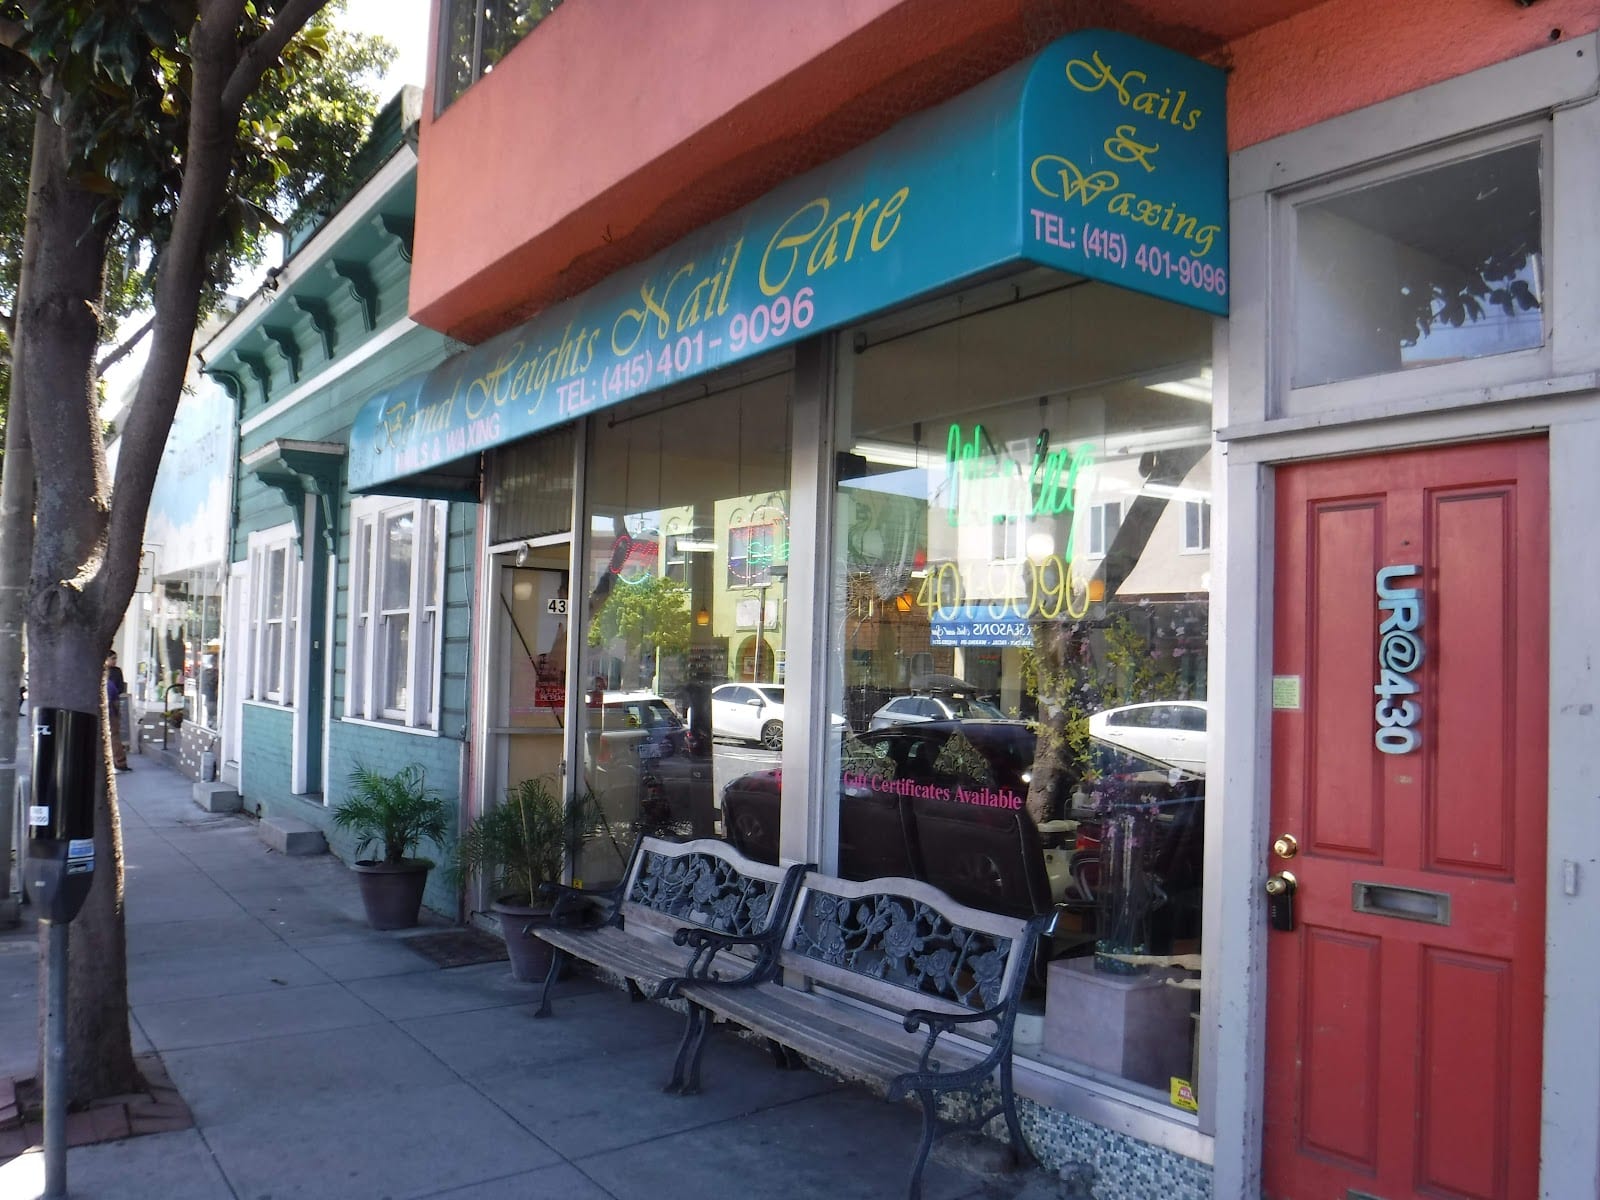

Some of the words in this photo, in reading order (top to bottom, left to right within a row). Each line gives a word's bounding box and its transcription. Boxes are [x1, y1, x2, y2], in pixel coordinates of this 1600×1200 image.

[1066, 50, 1201, 130] Nails
[1103, 125, 1159, 172] &
[1031, 154, 1221, 257] Waxing
[1030, 209, 1076, 249] TEL:
[1083, 223, 1127, 268] (415)
[1135, 243, 1226, 296] 401-9096
[465, 319, 601, 420] Heights
[611, 236, 744, 357] Nail
[758, 186, 909, 297] Care
[556, 380, 597, 414] TEL:
[602, 350, 654, 399] (415)
[447, 412, 500, 454] WAXING
[871, 773, 950, 801] Certificates
[955, 785, 1022, 810] Available
